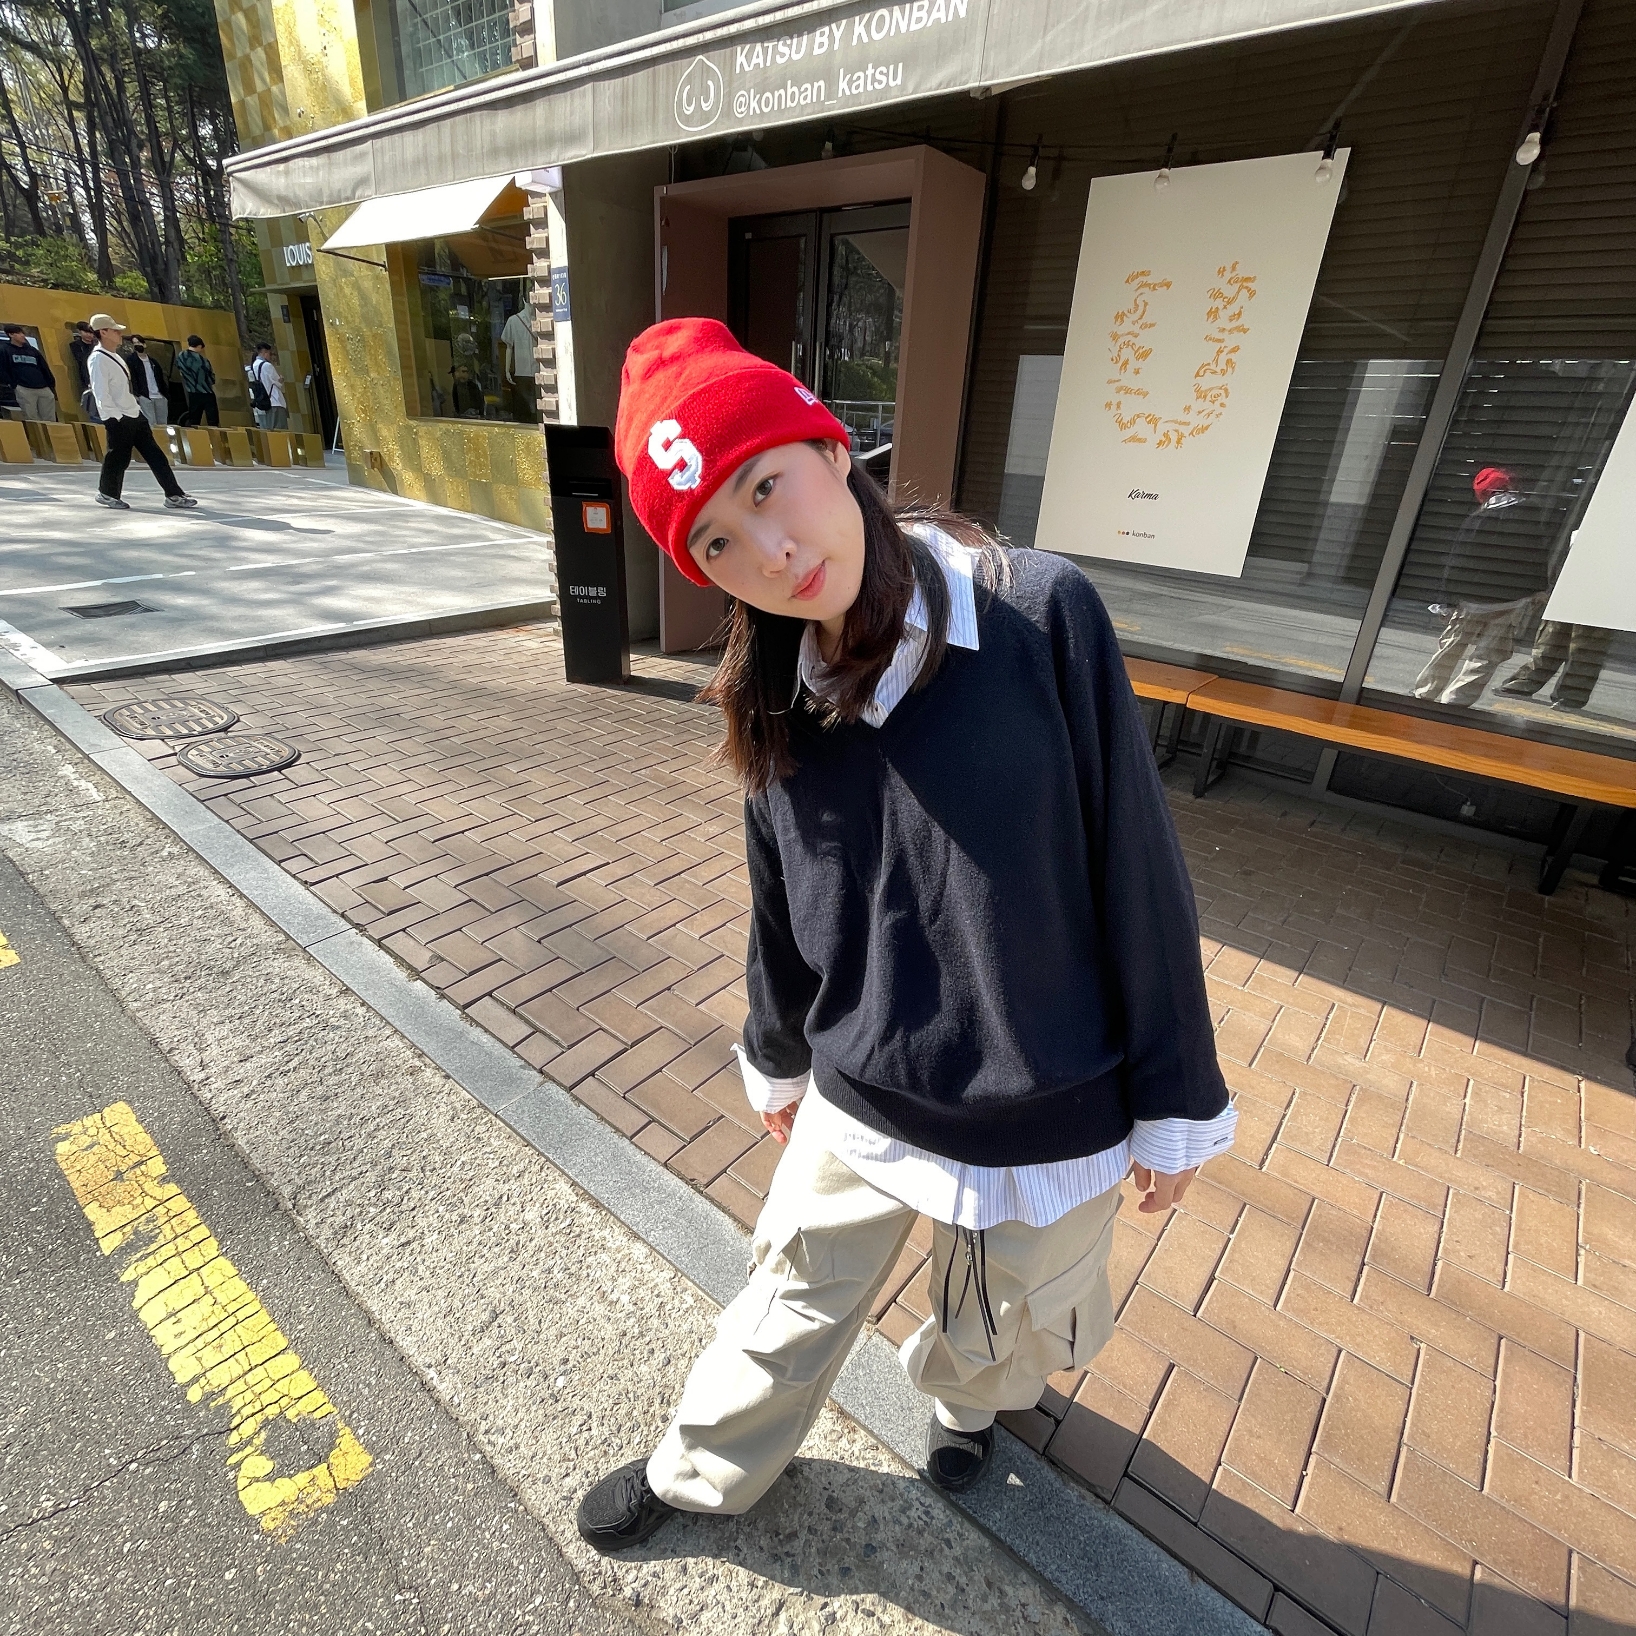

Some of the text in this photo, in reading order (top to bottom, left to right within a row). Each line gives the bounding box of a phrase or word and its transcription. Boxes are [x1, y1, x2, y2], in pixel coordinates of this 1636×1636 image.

[735, 0, 969, 74] KATSU BY KONBAN
[733, 62, 904, 118] @konban_katsu
[283, 242, 313, 266] LOUIS
[554, 282, 567, 306] 36
[648, 418, 703, 491] S
[1127, 488, 1160, 501] Karma
[1132, 530, 1156, 540] konban
[569, 585, 607, 597] 테이블링
